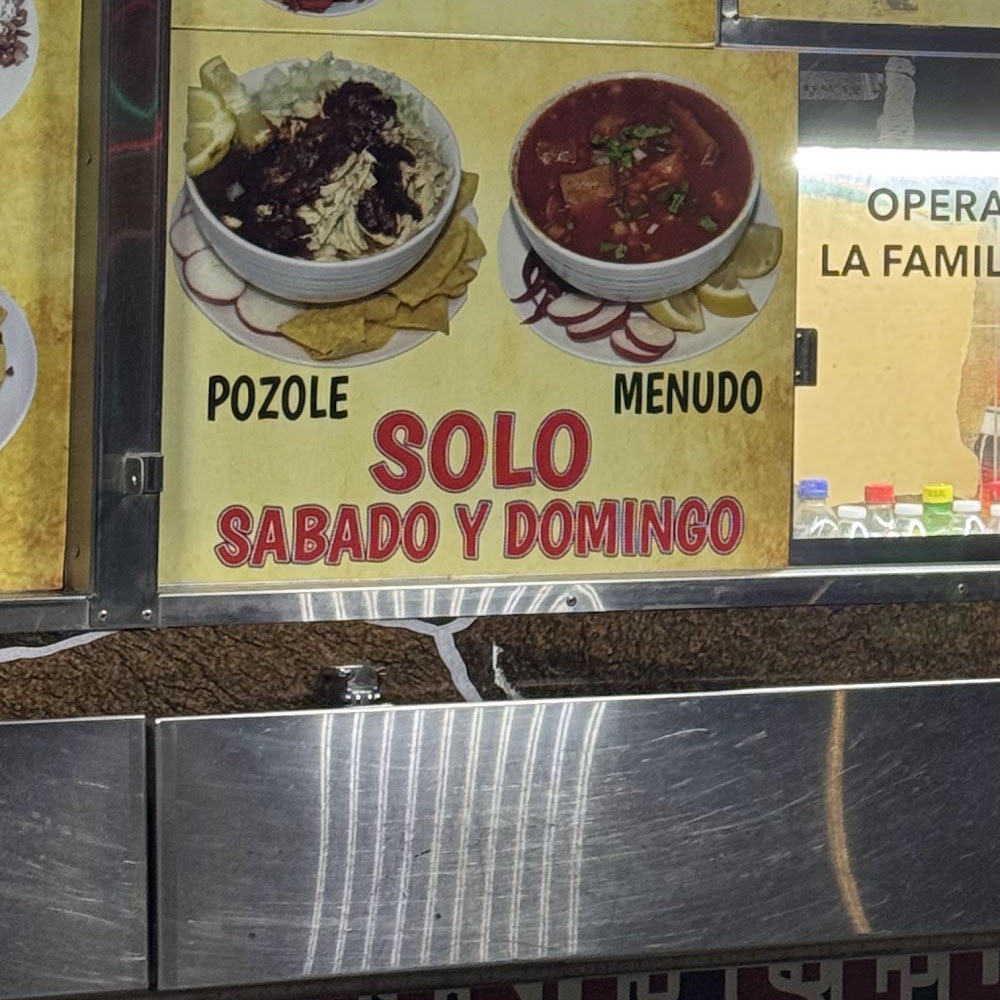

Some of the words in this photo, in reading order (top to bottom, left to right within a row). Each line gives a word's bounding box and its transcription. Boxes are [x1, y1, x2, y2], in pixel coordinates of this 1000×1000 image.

[820, 243, 870, 278] LA
[207, 374, 349, 421] POZOLE
[613, 369, 763, 415] MENUDO
[368, 408, 593, 494] SOLO
[214, 501, 441, 568] SABADO
[454, 499, 493, 560] Y
[503, 495, 745, 560] DOMINGO
